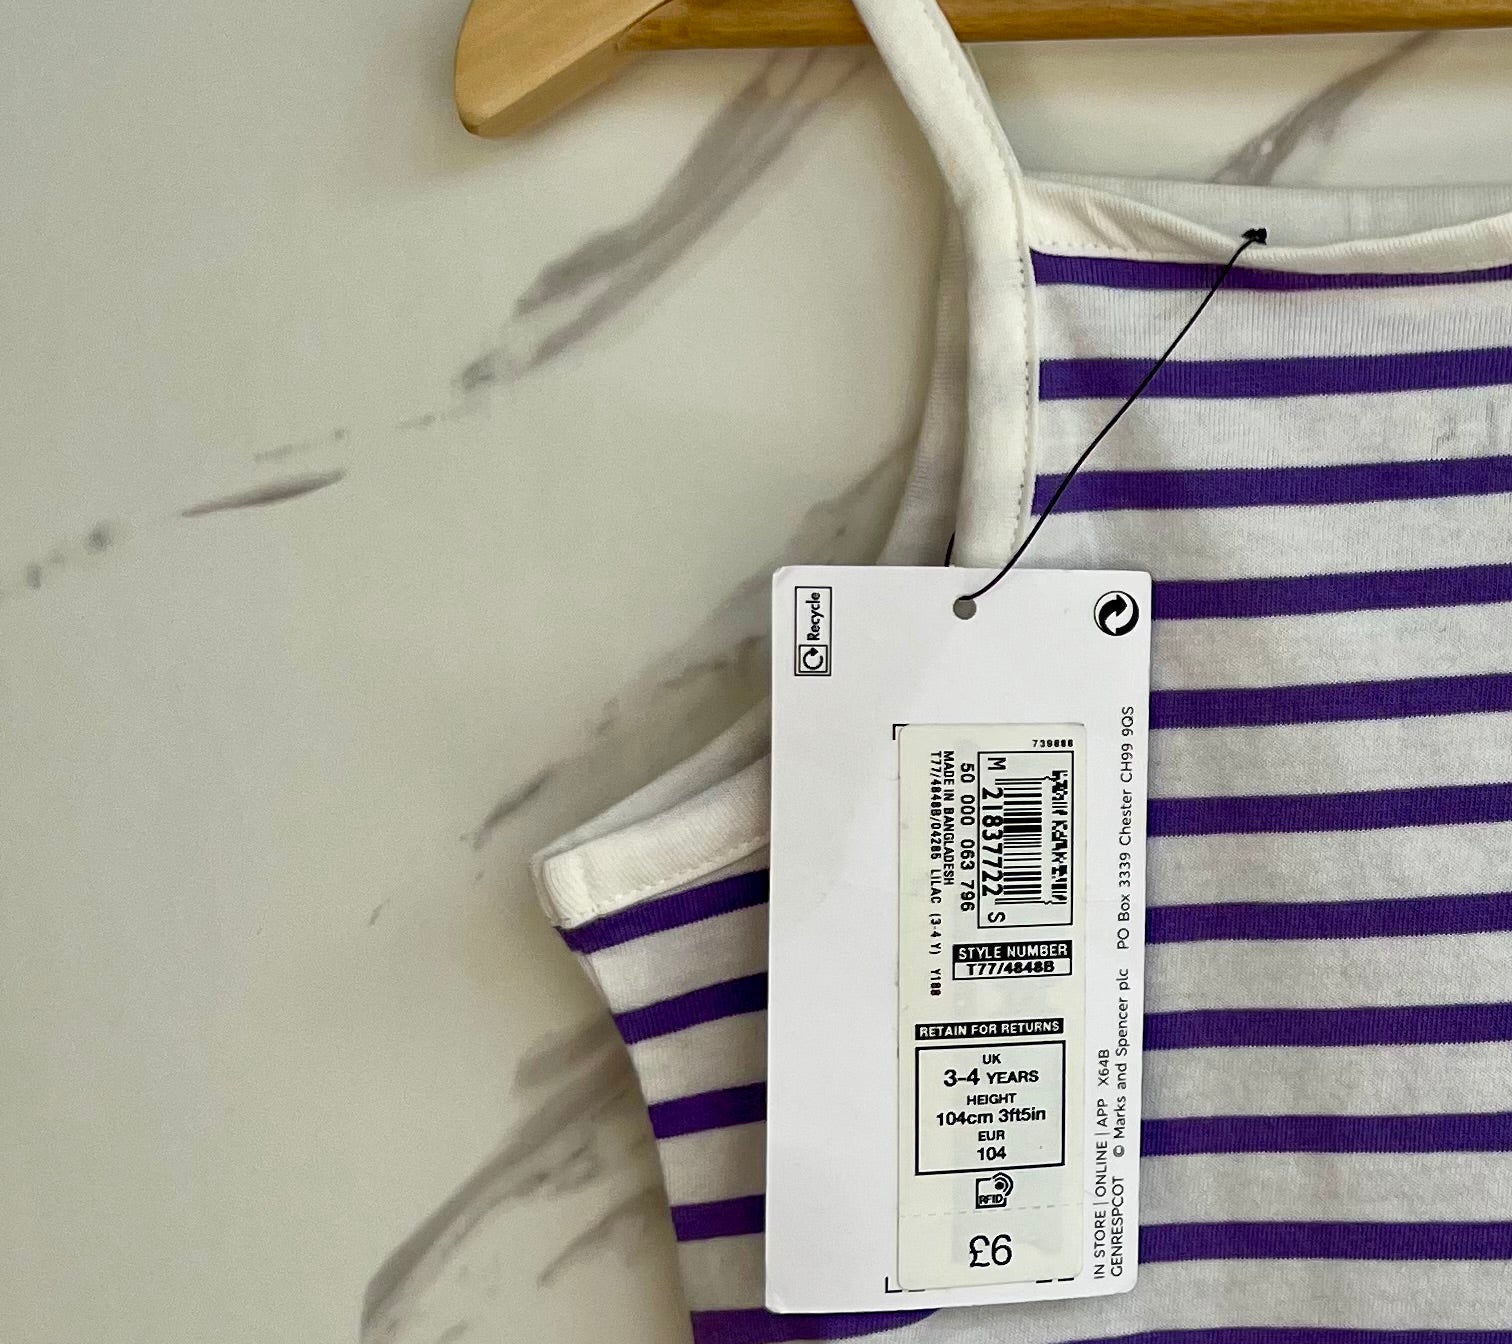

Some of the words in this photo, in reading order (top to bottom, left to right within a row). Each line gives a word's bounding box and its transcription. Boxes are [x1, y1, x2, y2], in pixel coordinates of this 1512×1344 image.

[805, 592, 824, 641] Recycle
[1121, 706, 1134, 737] 9QS
[943, 750, 955, 786] MADE
[960, 762, 976, 784] 50
[987, 757, 1007, 771] M
[1120, 743, 1134, 783] CH99
[943, 788, 955, 802] IN
[960, 794, 976, 826] 000
[1118, 788, 1133, 846] Chester
[943, 807, 955, 886] BANGLADESH
[960, 838, 976, 871] 063
[981, 786, 1004, 897] 21837722
[1118, 852, 1131, 888] 3339
[930, 869, 942, 904] LILAC
[960, 879, 976, 912] 796
[987, 911, 1006, 924] S
[1117, 894, 1131, 922] Box
[958, 946, 1001, 960] STYLE
[1007, 943, 1068, 958] NUMBER
[1116, 927, 1130, 950] PO
[965, 960, 1056, 976] T77/4848B
[1115, 968, 1131, 991] plc
[919, 1025, 967, 1038] RETAIN
[971, 1023, 997, 1035] FOR
[1001, 1020, 1060, 1034] RETURNS
[1115, 996, 1130, 1057] Spencer
[982, 1053, 1002, 1065] UK
[1097, 1049, 1110, 1087] X64B
[943, 1067, 981, 1088] 3-4
[986, 1069, 1040, 1085] YEARS
[1114, 1062, 1128, 1090] and
[966, 1092, 1017, 1106] HEIGHT
[1096, 1098, 1108, 1128] APP
[936, 1111, 994, 1127] 104cm
[998, 1106, 1046, 1123] 3ft5in
[1113, 1095, 1127, 1139] Marks
[977, 1129, 1006, 1142] EUR
[976, 1145, 1007, 1161] 104
[1094, 1140, 1108, 1198] ONLINE
[979, 1193, 1003, 1205] RFID
[1093, 1210, 1107, 1258] STORE
[1110, 1176, 1124, 1277] GENRESPCOT
[969, 1233, 1013, 1268] £6
[1093, 1264, 1105, 1280] IN
